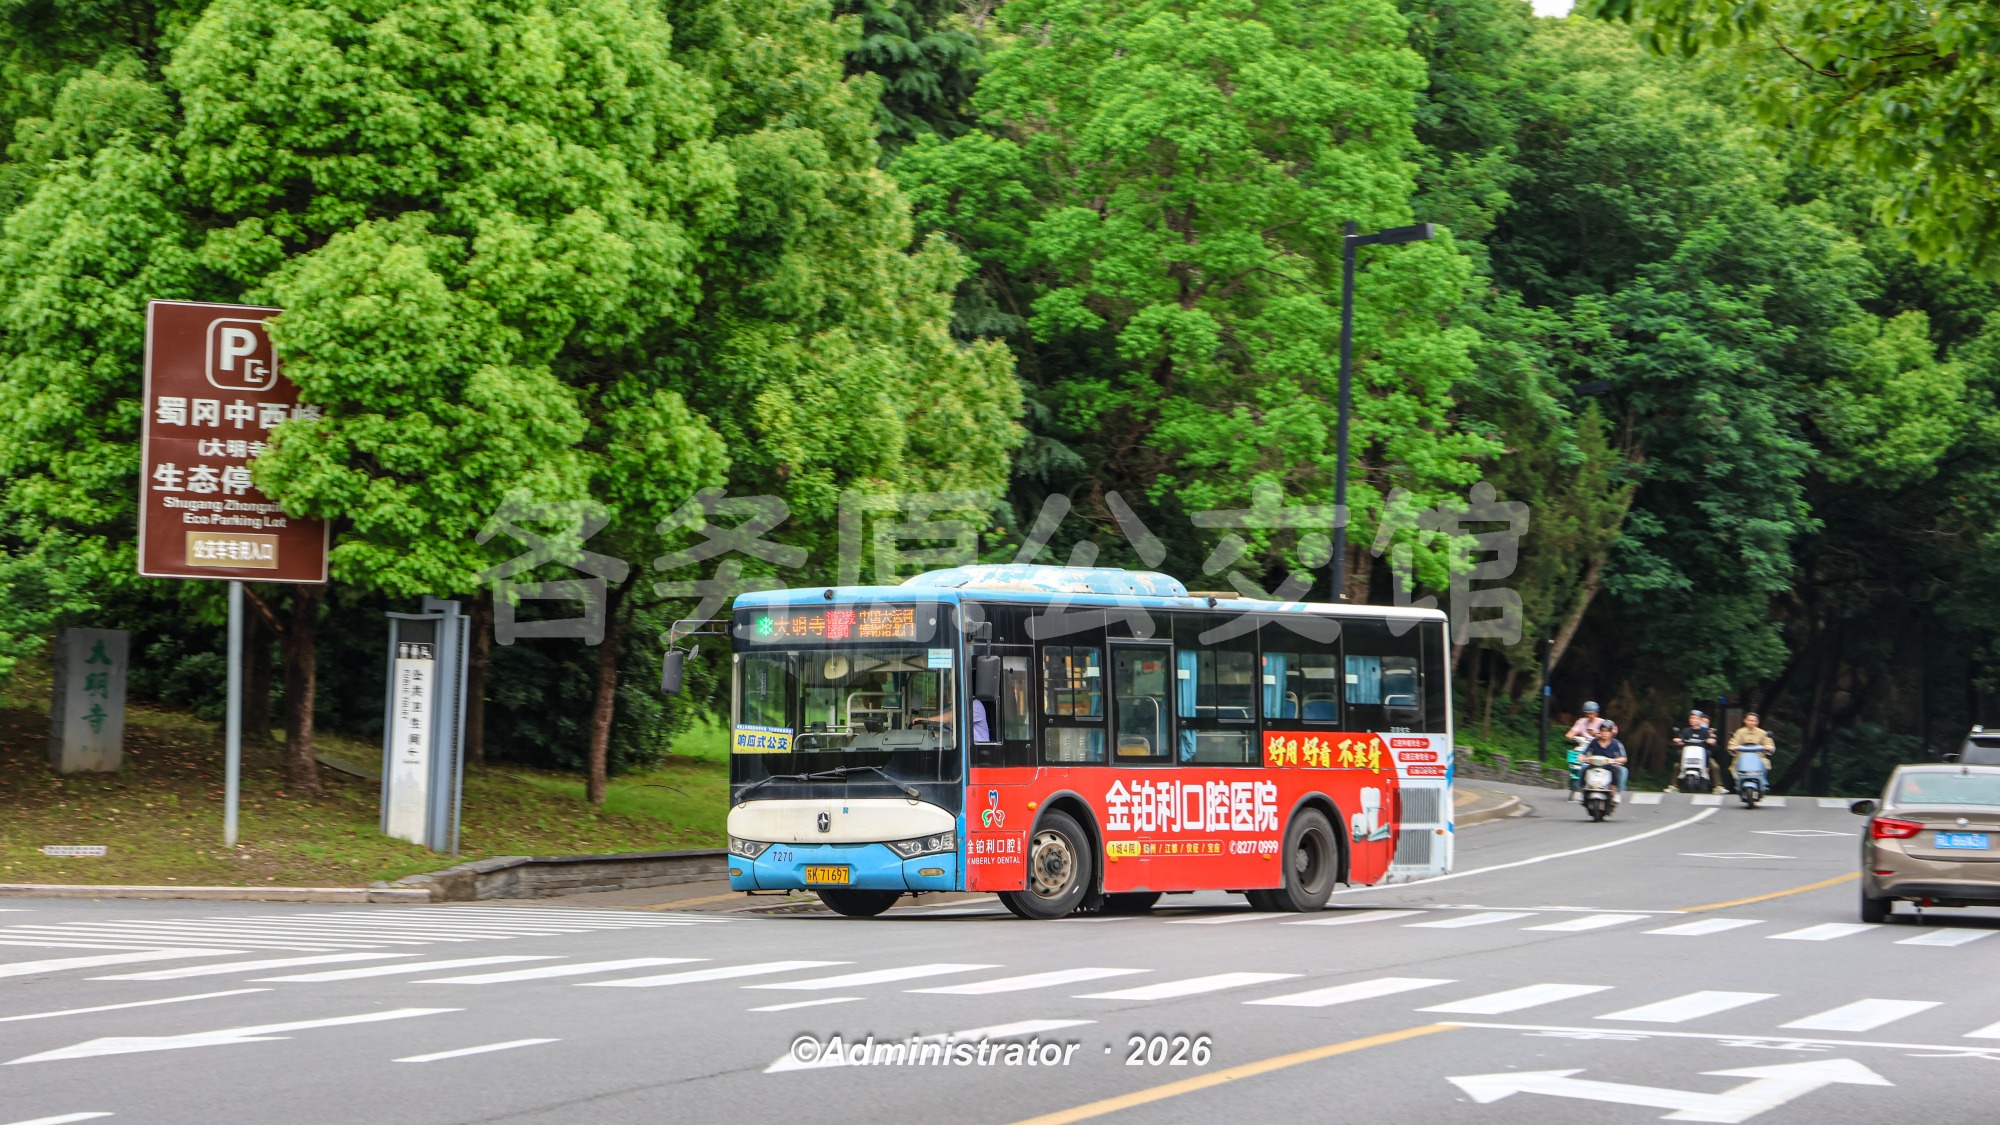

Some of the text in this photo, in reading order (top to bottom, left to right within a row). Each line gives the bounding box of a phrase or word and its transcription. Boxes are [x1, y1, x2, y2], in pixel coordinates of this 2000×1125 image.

[219, 326, 258, 372] P
[197, 437, 274, 459] (大明寺
[152, 462, 260, 496] 生态停
[163, 496, 283, 514] Shugang Zhongxi
[183, 512, 287, 529] Eco Parking Lot
[859, 609, 914, 624] 中国大运河
[773, 616, 826, 637] 大明寺
[81, 638, 113, 735] 大明寺
[737, 733, 788, 750] 响应式公交
[1268, 735, 1382, 775] 好用 好看 不塞牙
[1105, 779, 1278, 833] 金铂利口腔医院
[967, 838, 1016, 855] 金铂利口腔
[1237, 840, 1279, 855] 8277 0999
[773, 851, 793, 862] 7270
[967, 856, 1021, 865] KMBERLY DENTAL
